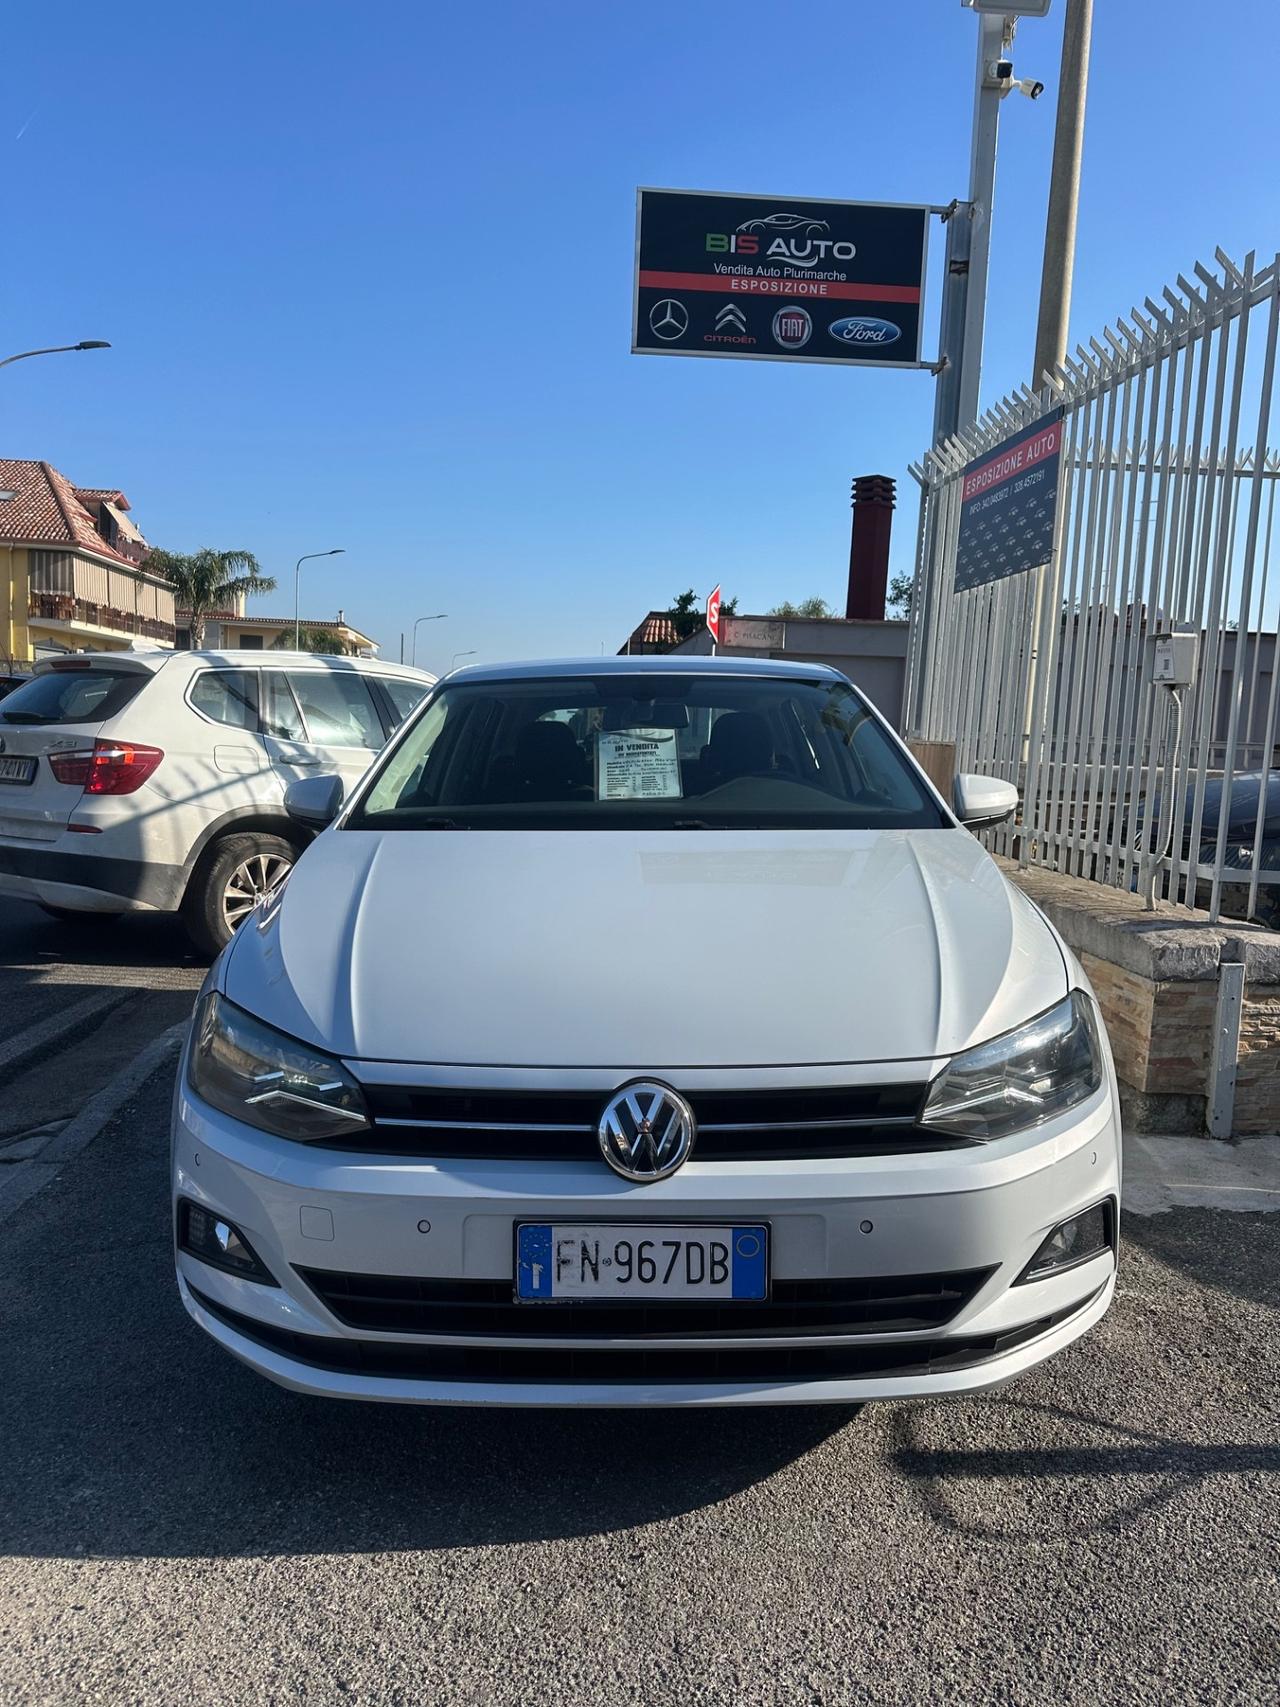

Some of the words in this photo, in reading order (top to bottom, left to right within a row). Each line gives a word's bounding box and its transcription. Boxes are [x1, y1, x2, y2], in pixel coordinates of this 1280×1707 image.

[705, 233, 760, 255] BIS
[766, 237, 857, 260] AUTO
[713, 262, 754, 276] Vendita
[756, 265, 781, 278] Auto
[783, 267, 847, 281] Plurimarche
[731, 279, 828, 295] ESPOSIZIONE
[781, 319, 804, 338] FIAT
[843, 320, 887, 342] Ford
[966, 451, 1023, 495] ESPOSIZIONE
[1026, 433, 1055, 462] AUTO
[615, 744, 624, 752] IN
[626, 743, 659, 751] VENDITA
